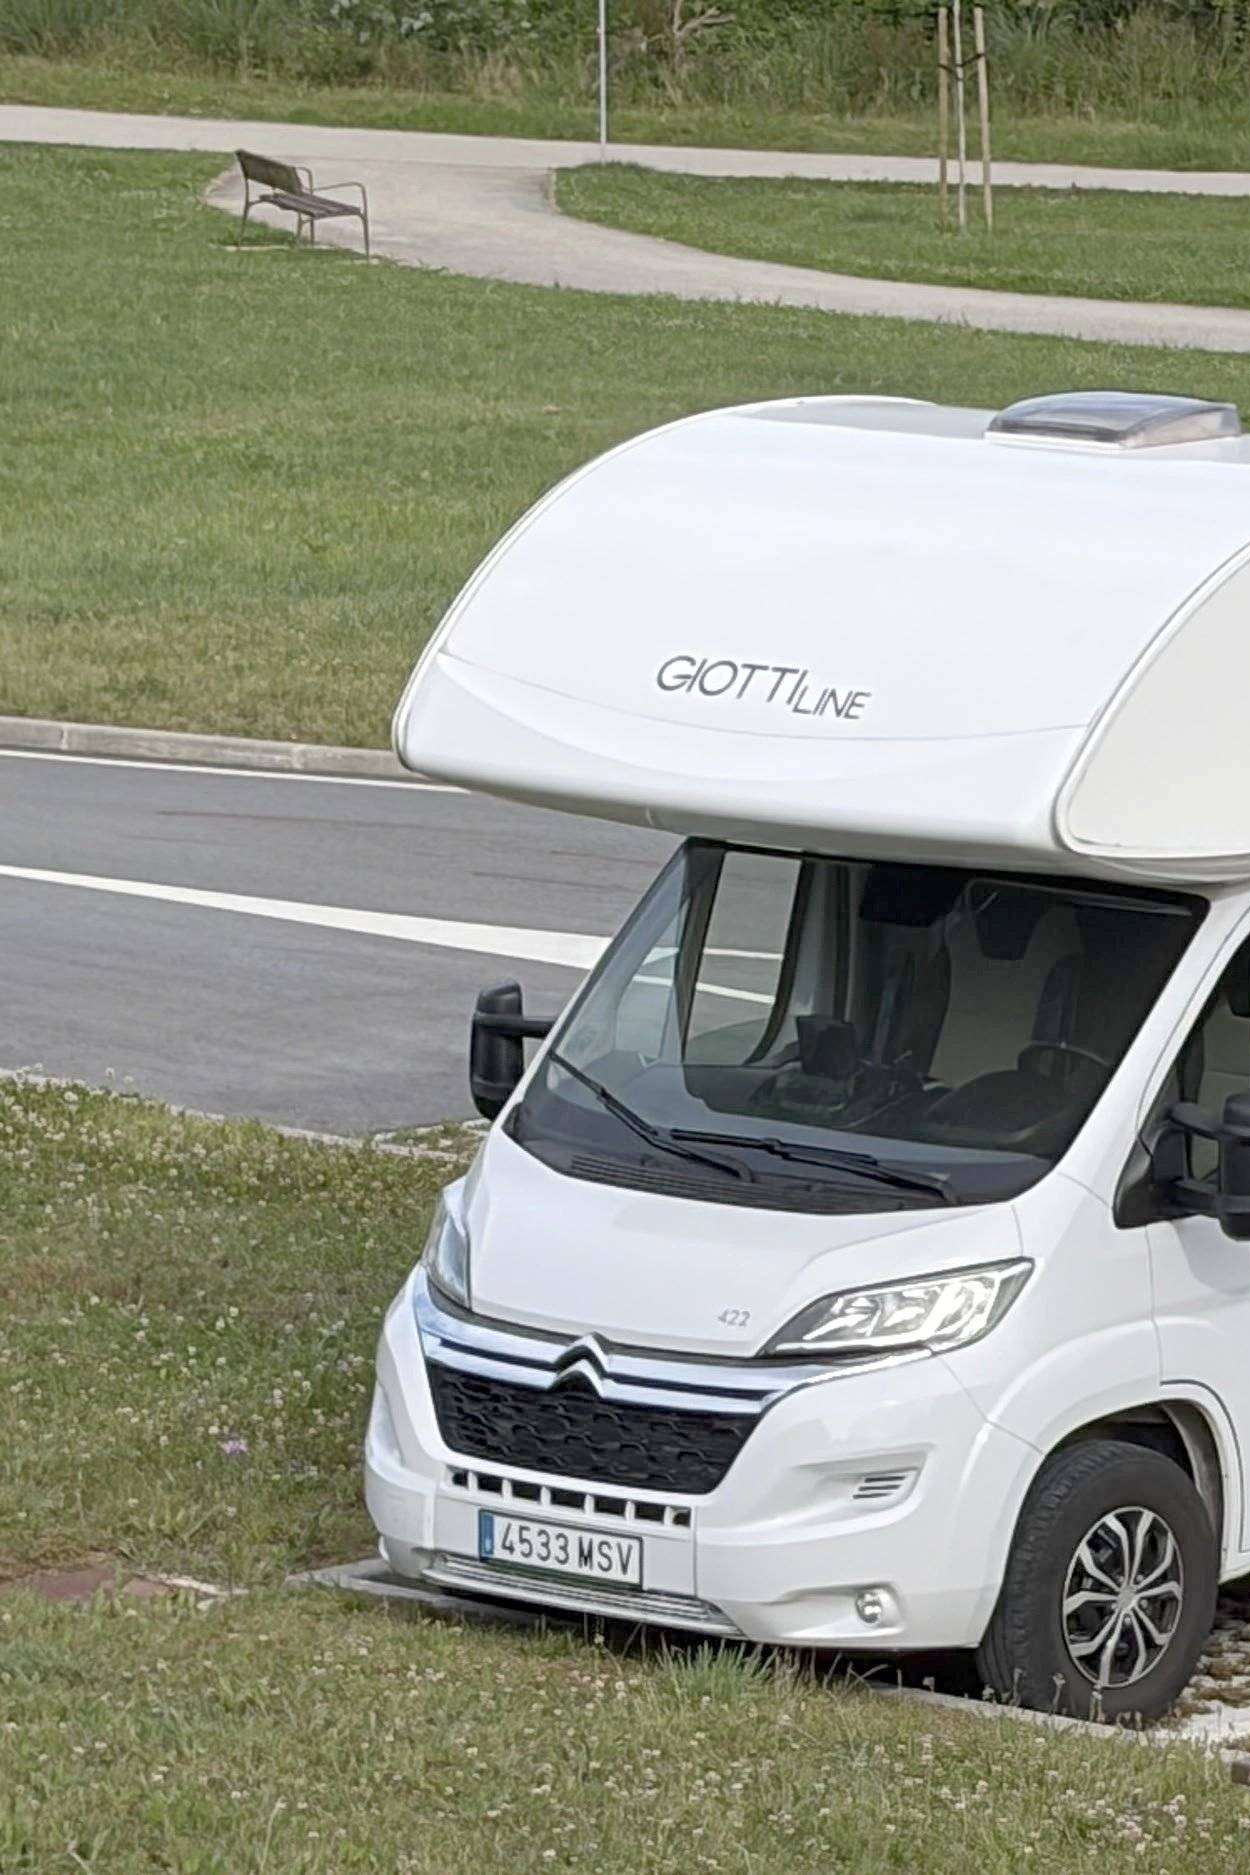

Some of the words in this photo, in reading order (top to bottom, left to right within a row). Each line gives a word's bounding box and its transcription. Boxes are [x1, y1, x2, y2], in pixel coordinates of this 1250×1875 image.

[718, 1309, 751, 1327] 422
[501, 1522, 570, 1565] 4533
[578, 1536, 633, 1576] MSV
